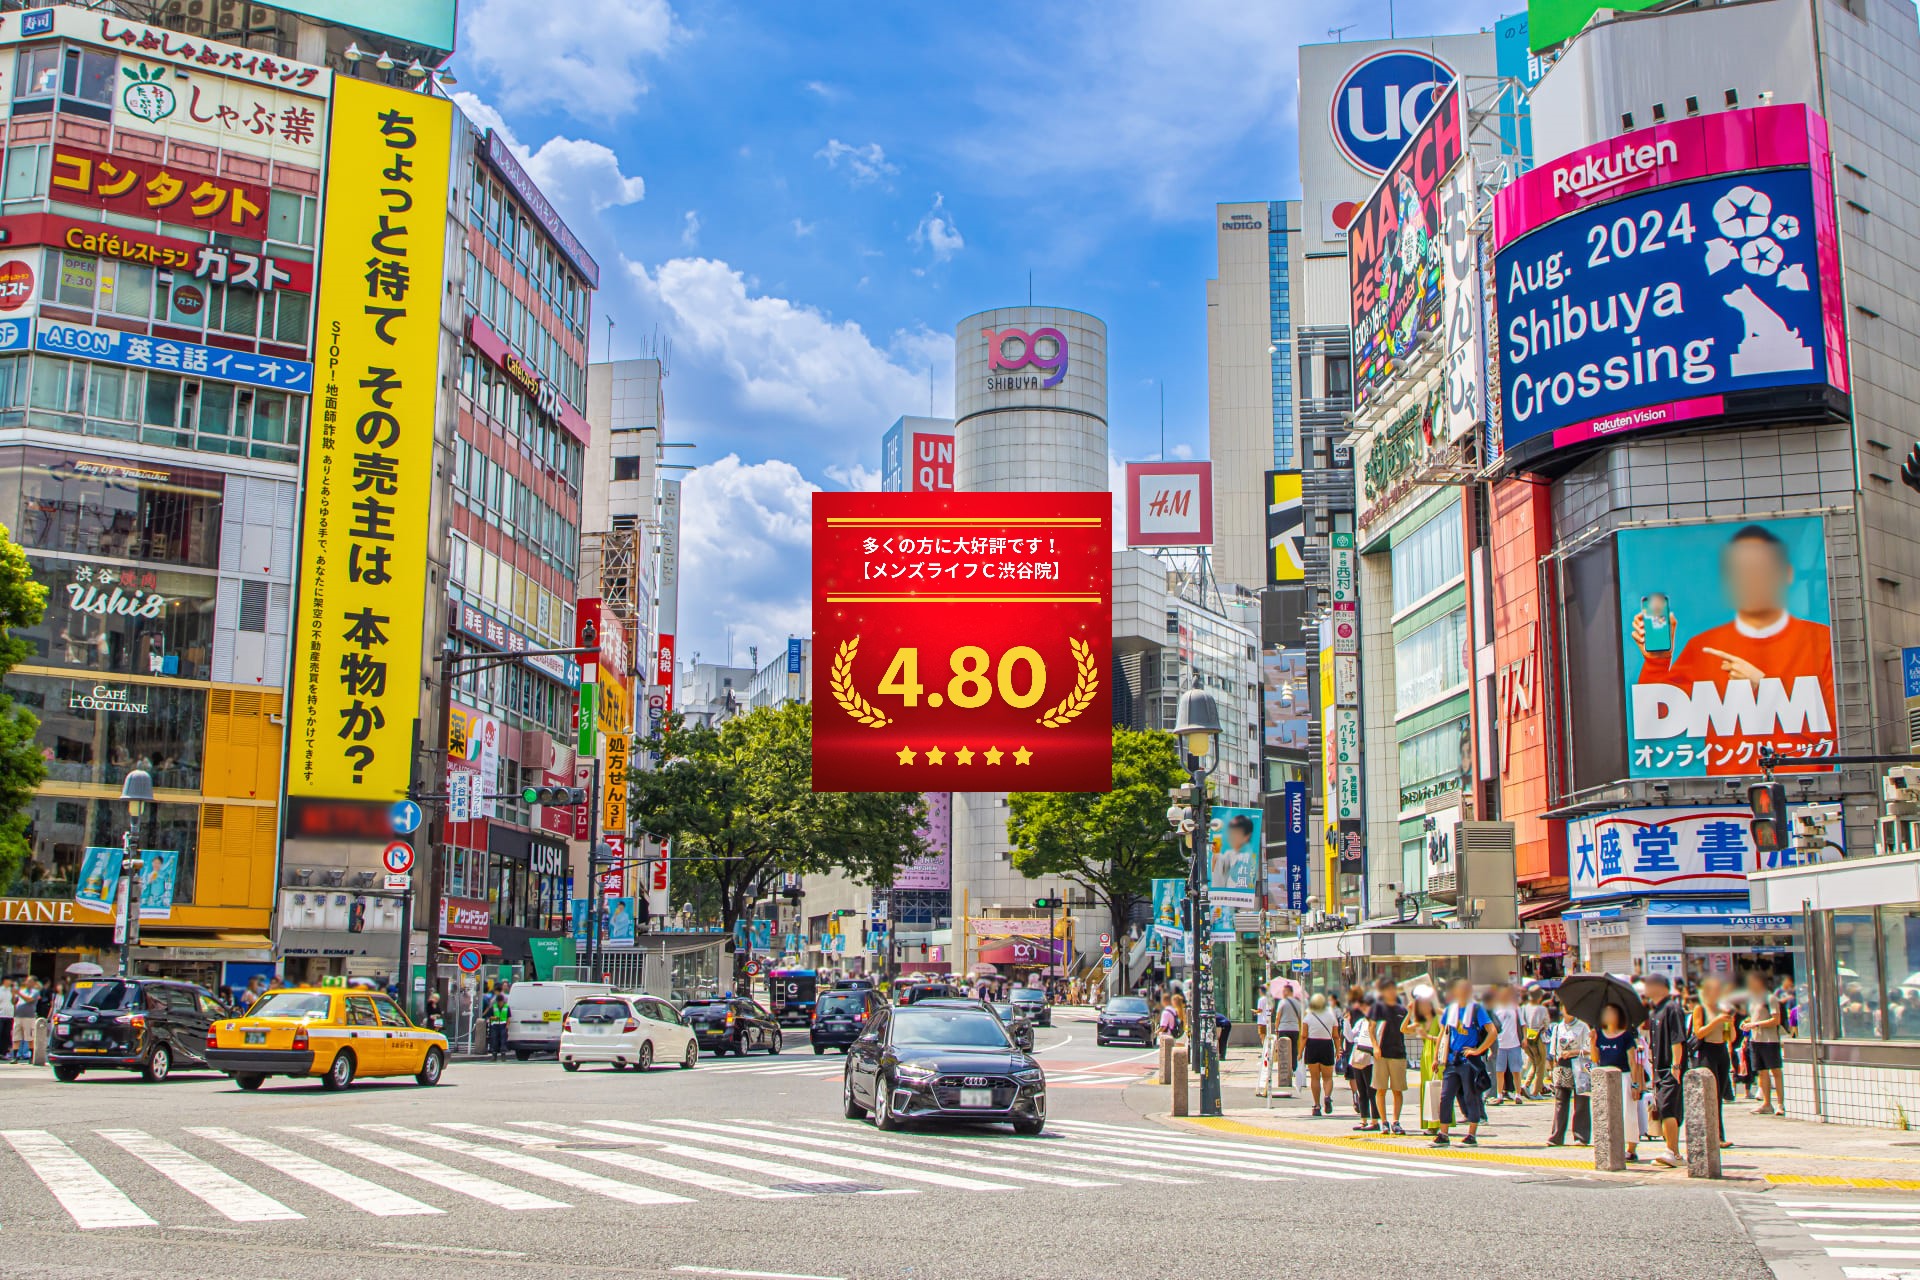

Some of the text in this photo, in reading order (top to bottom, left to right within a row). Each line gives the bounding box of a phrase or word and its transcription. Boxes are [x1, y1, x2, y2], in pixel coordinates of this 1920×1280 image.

[26, 12, 50, 31] 寿司
[101, 18, 320, 87] しゃぶしゃぶバイキング
[188, 84, 316, 146] しゃぶ葉
[53, 153, 263, 225] コンタクト
[1553, 138, 1678, 198] Rakuten
[364, 108, 417, 346] ちょっと待て
[1222, 221, 1262, 231] INDIGO
[65, 258, 95, 273] OPEN
[196, 246, 291, 292] ガスト
[1508, 251, 1572, 304] Aug.
[1587, 202, 1697, 269] 2024
[1508, 281, 1685, 364] Shibuya
[48, 326, 308, 385] AEON 英会話イーオン
[981, 327, 1069, 390] 109
[987, 377, 1038, 391] SHIBUYA
[1511, 336, 1716, 423] Crossing
[1593, 408, 1667, 433] Rakuten Vision
[349, 366, 402, 585] その売主は
[1149, 489, 1192, 517] H&M
[66, 583, 165, 619] Ushi8
[567, 663, 580, 687] 4F
[661, 647, 672, 673] 免税
[338, 606, 391, 785] 本物か?
[1632, 675, 1832, 740] DMM
[581, 707, 590, 730] レイク
[607, 737, 625, 802] 処方せん
[457, 775, 466, 817] 渋谷駅前
[610, 804, 620, 828] 3F
[1292, 792, 1302, 834] MIZUHO
[531, 842, 562, 876] LUSH
[1728, 916, 1786, 925] TAISEIDO
